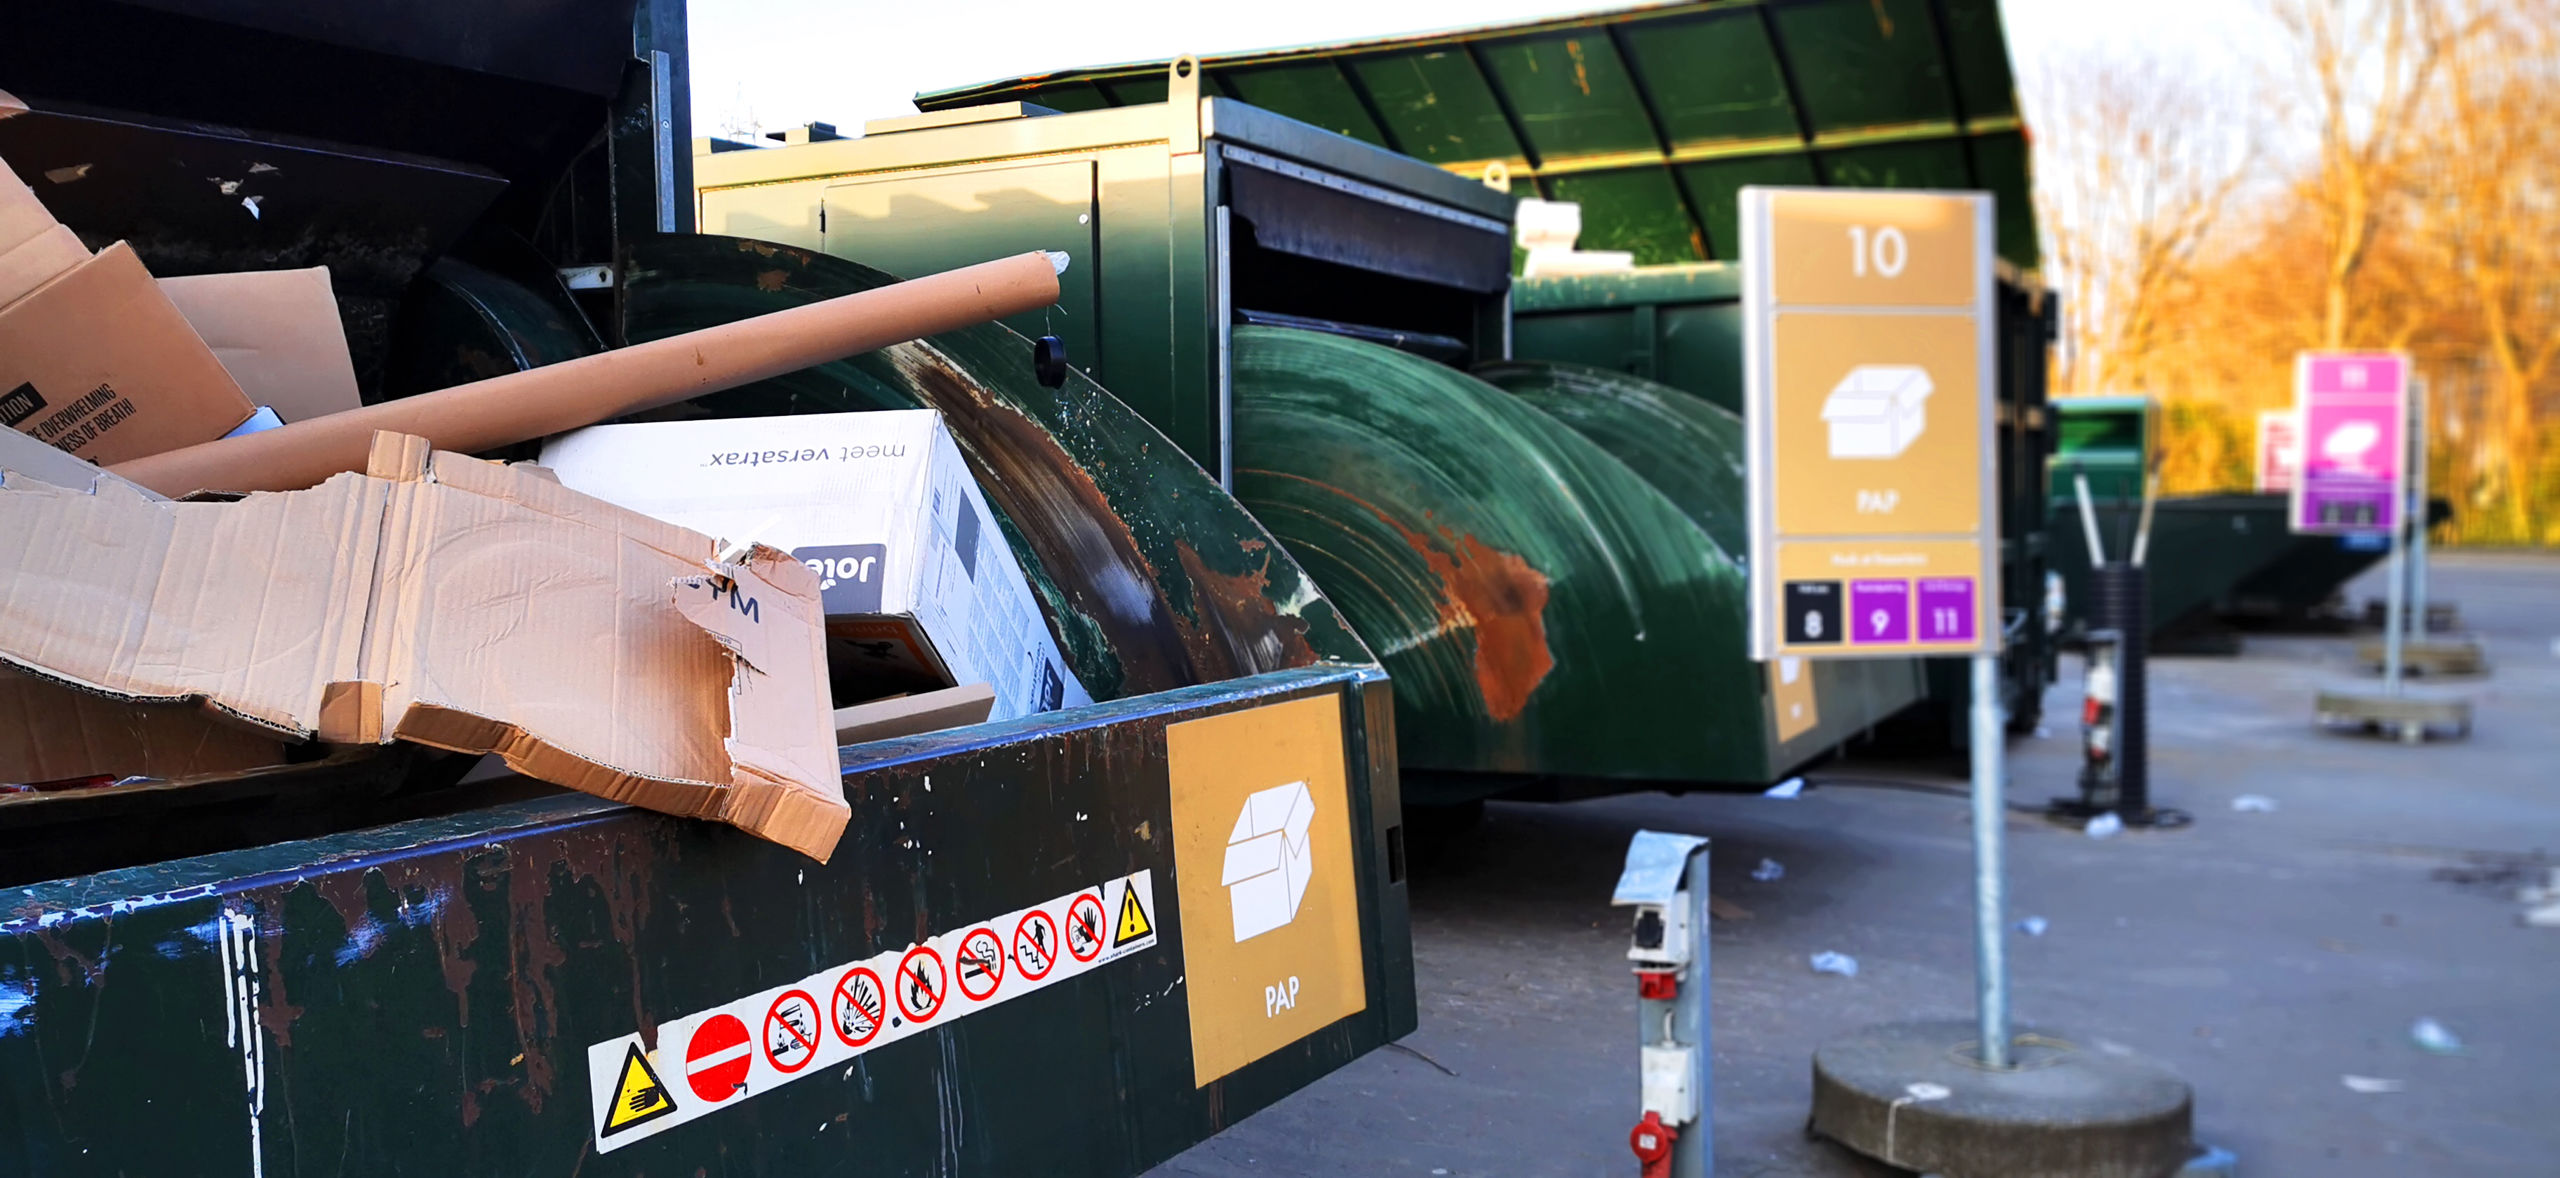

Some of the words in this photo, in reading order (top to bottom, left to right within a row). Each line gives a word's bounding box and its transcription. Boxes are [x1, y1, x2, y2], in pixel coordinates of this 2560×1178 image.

[1846, 225, 1907, 277] 10
[40, 383, 117, 438] OVERWHELMING
[80, 421, 98, 440] OF
[93, 398, 137, 432] BREATH!
[838, 444, 906, 462] meet
[1856, 490, 1900, 514] PAP
[1804, 610, 1823, 638] 8
[1870, 609, 1890, 637] 9
[1933, 608, 1958, 635] 11
[1265, 975, 1300, 1019] PAP
